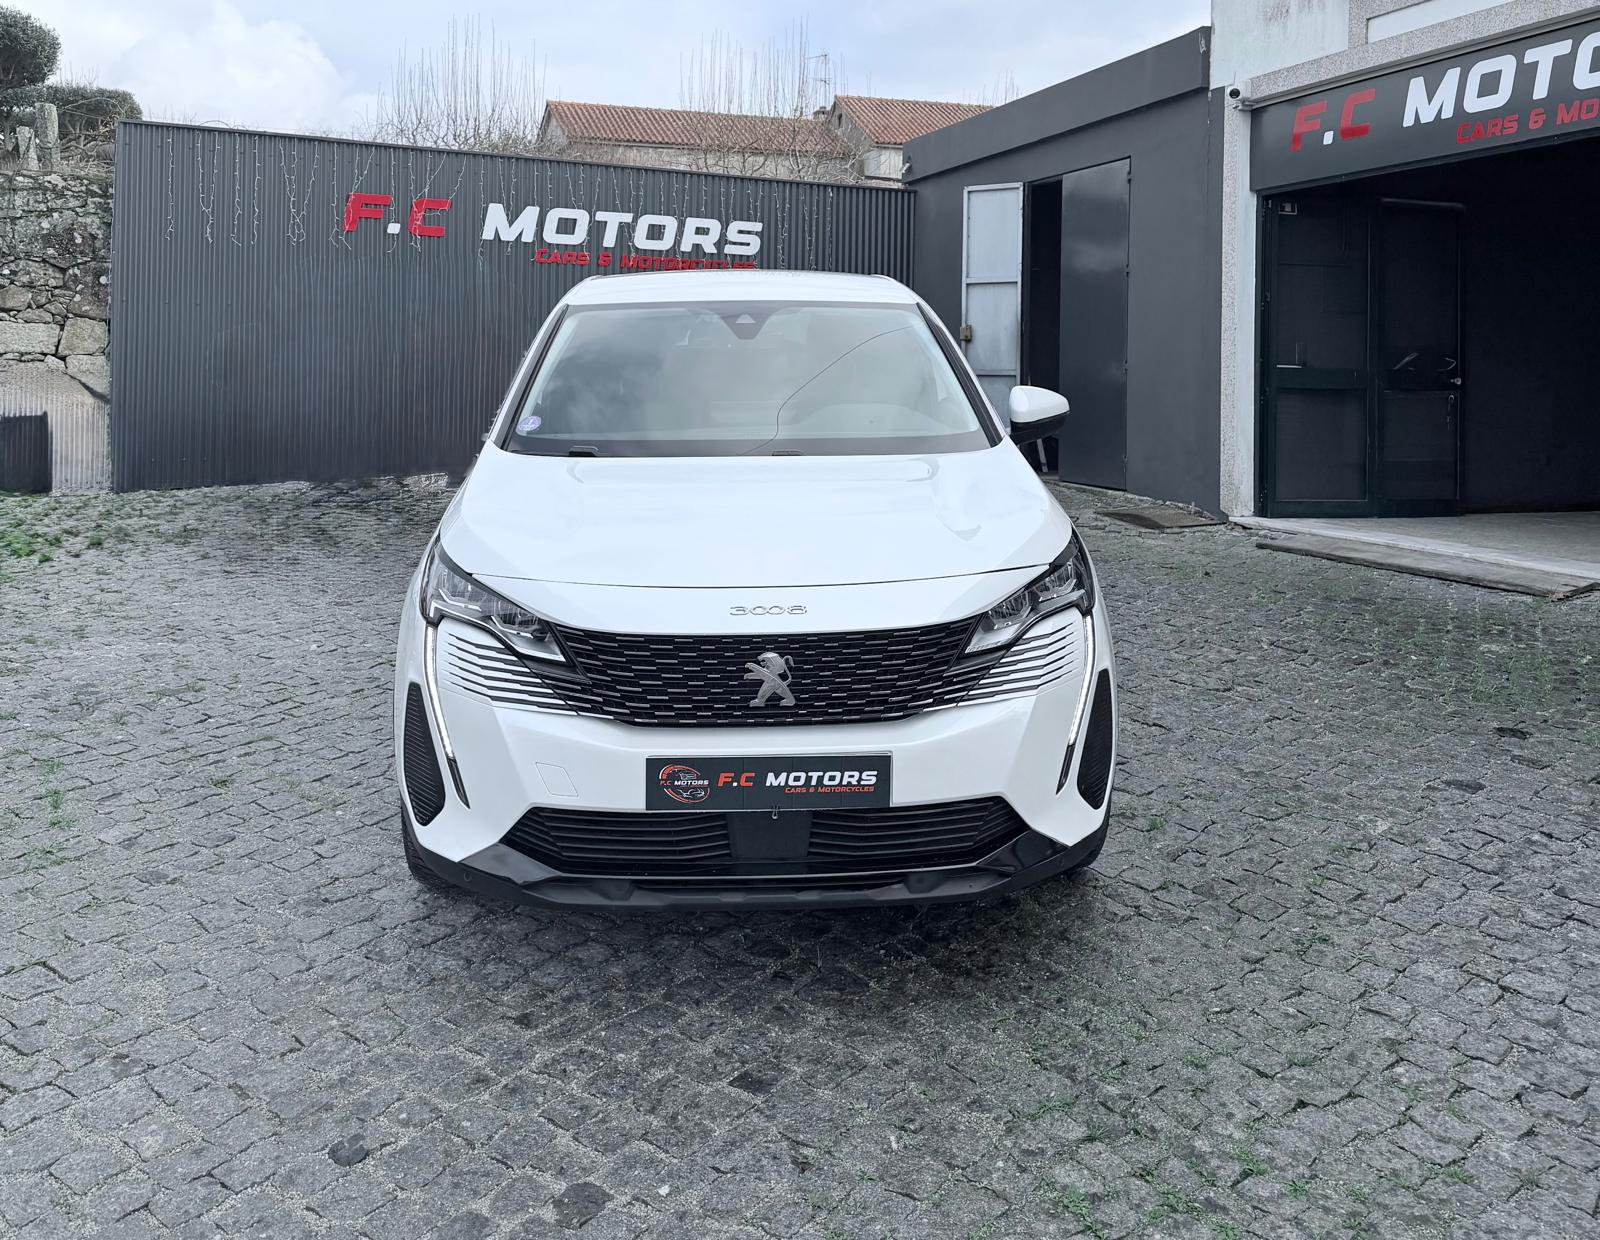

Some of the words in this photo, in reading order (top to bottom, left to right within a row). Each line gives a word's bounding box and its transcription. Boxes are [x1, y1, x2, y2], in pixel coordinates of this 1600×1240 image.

[1289, 88, 1376, 151] F.C
[1456, 114, 1519, 144] CARS
[1528, 107, 1547, 130] &
[343, 193, 452, 237] F.C
[482, 203, 763, 256] MOTORS
[535, 248, 590, 266] CARS
[598, 252, 611, 267] &
[729, 605, 807, 616] 3008
[717, 772, 755, 787] F.C
[765, 770, 878, 787] MOTORS
